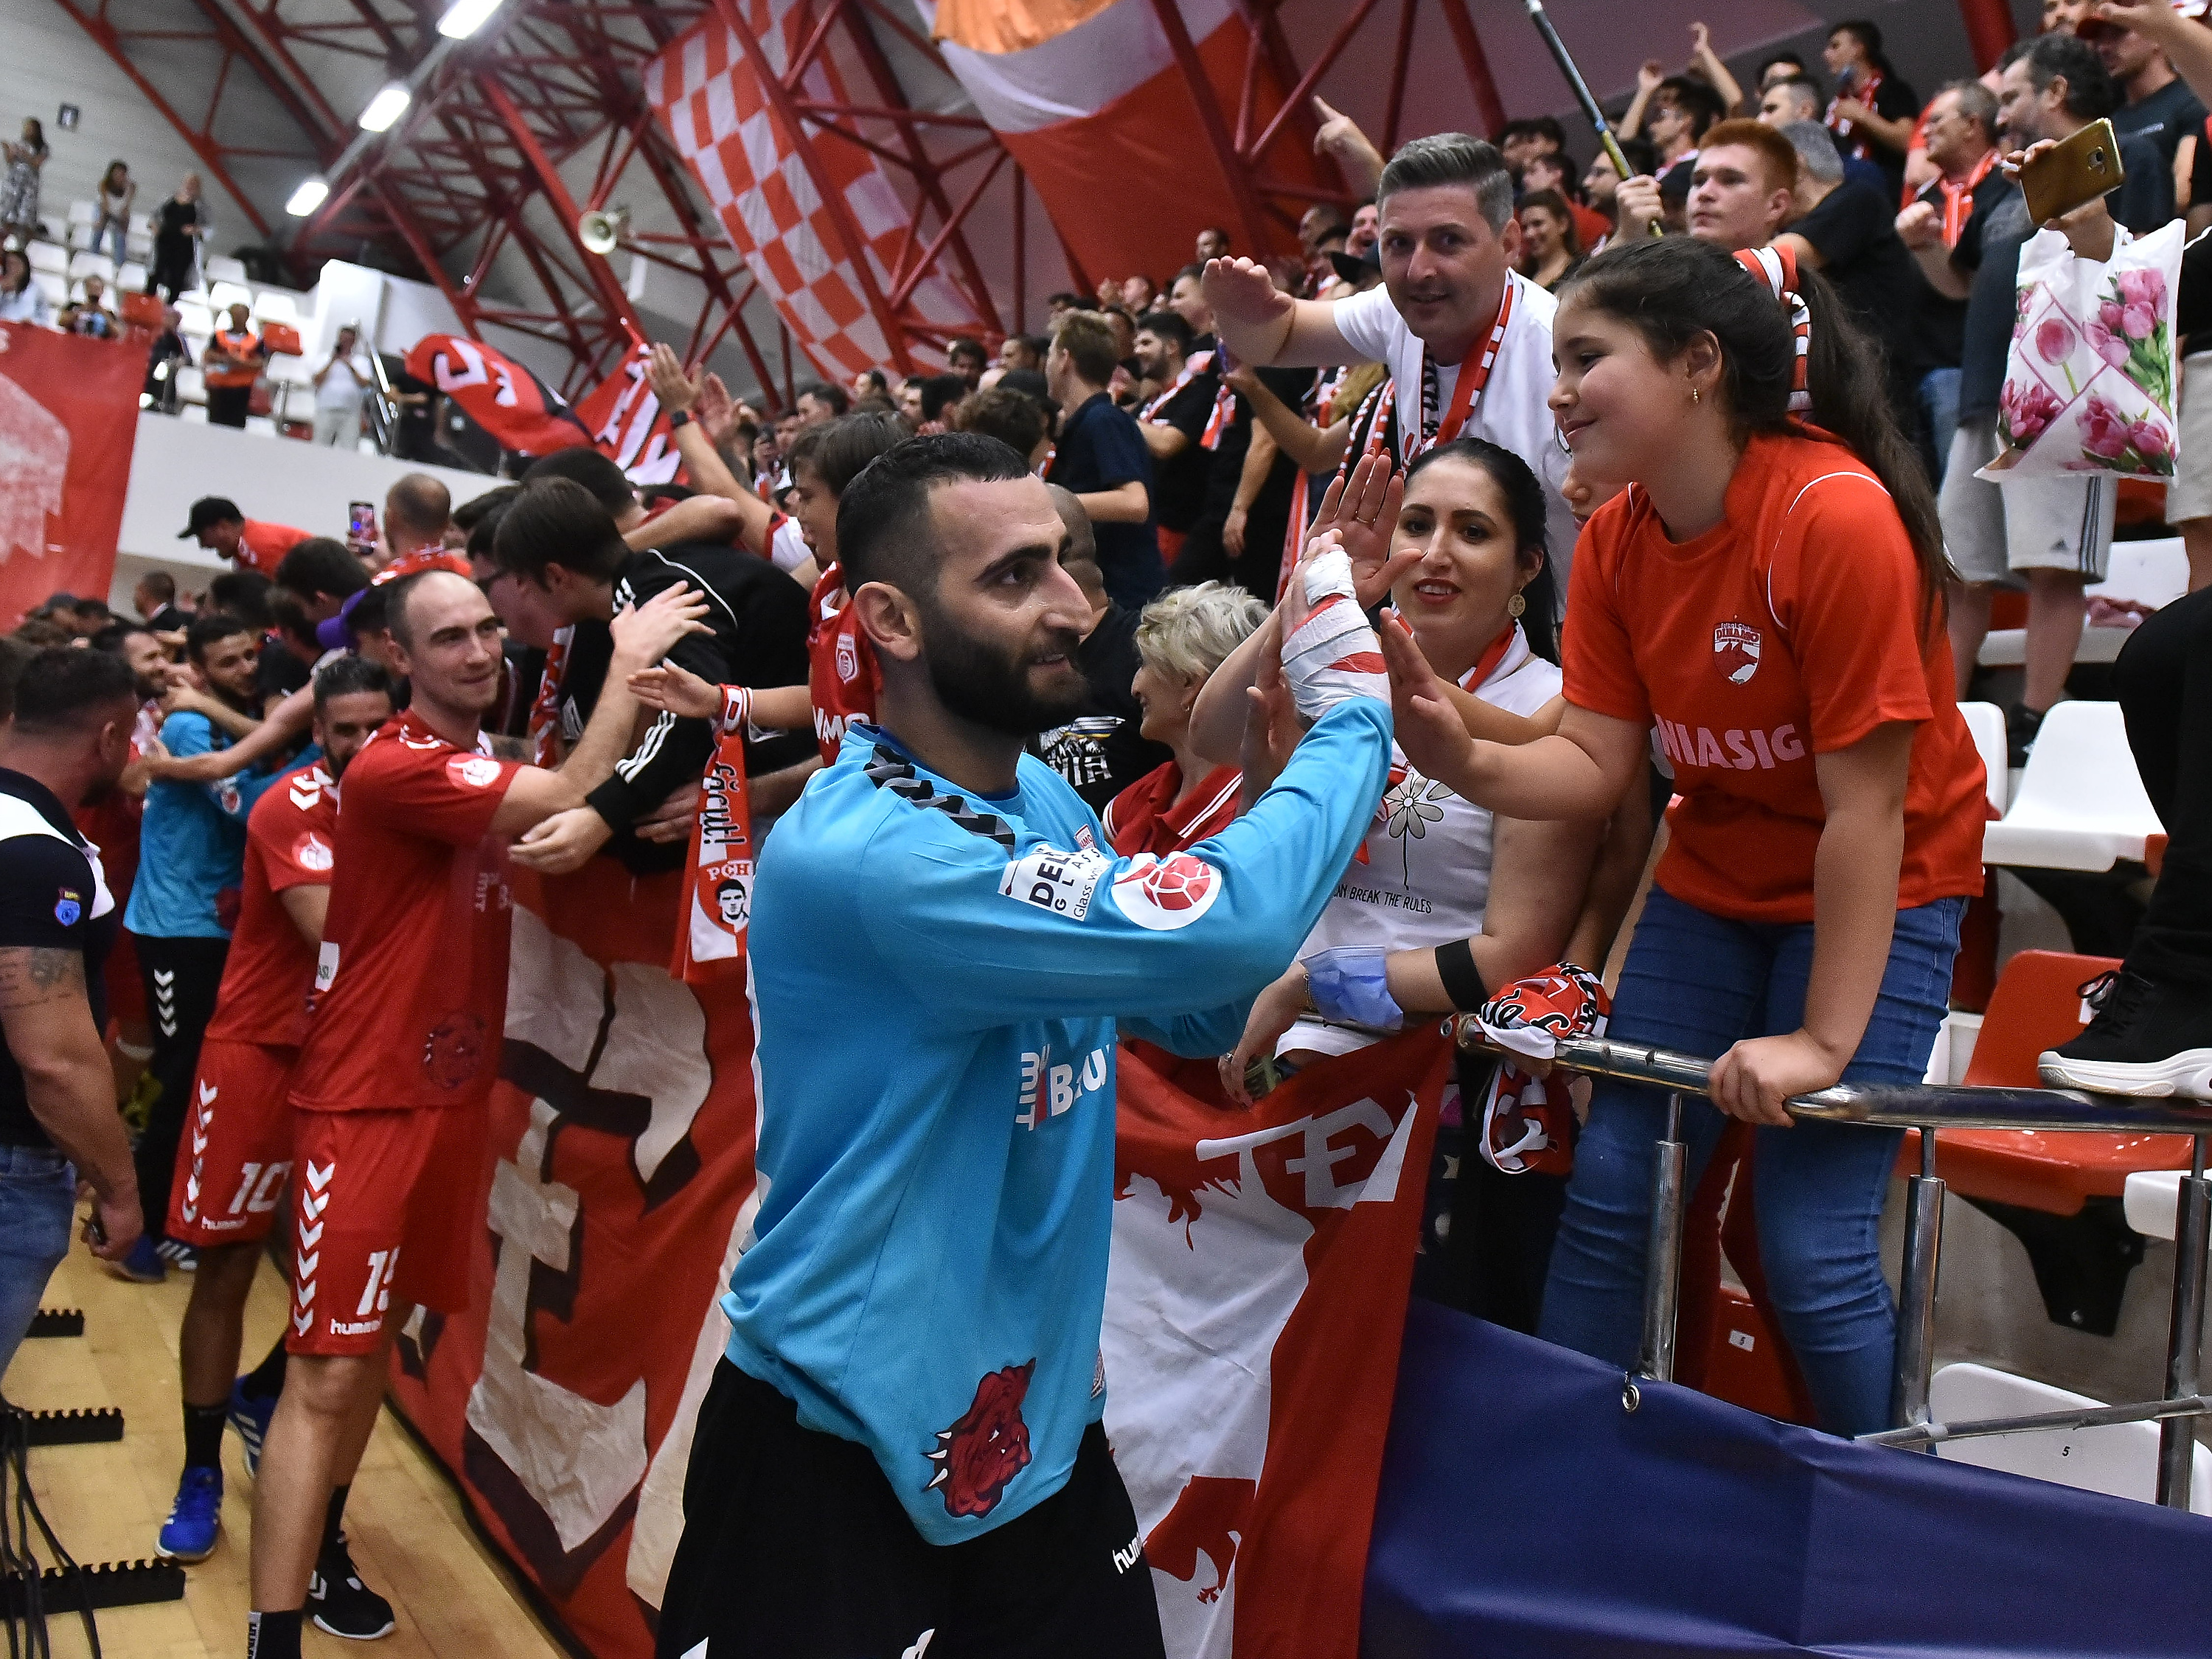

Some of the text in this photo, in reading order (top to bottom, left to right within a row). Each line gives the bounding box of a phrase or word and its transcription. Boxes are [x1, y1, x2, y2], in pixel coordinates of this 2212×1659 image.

[706, 861, 751, 883] PCH
[1029, 853, 1071, 908] DEL
[1074, 884, 1093, 917] Glass
[1334, 883, 1433, 914] AN BREAK THE RULES
[227, 1161, 294, 1215] 10
[2062, 1445, 2070, 1457] 5
